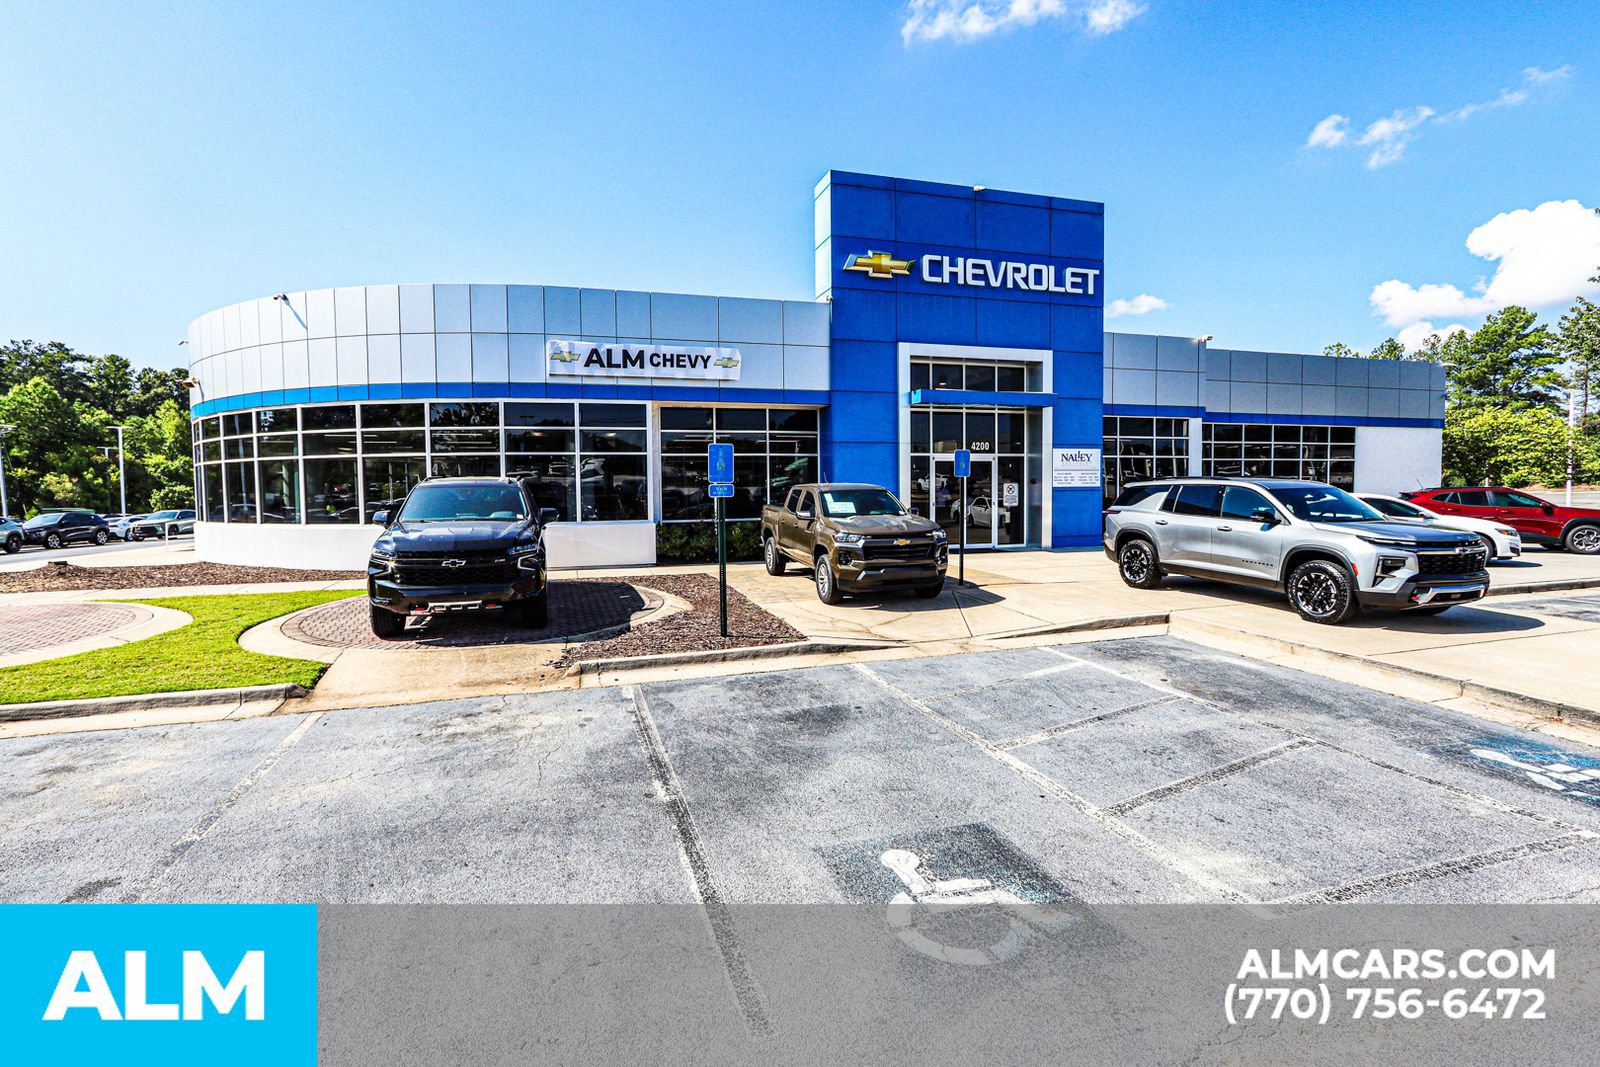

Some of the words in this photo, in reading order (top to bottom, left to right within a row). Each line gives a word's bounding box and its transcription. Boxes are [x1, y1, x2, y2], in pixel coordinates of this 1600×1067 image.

[922, 254, 1100, 295] CHEVROLET
[584, 348, 645, 370] ALM
[649, 352, 712, 370] CHEVY
[971, 441, 990, 451] 4200
[1061, 451, 1093, 462] NALLEY
